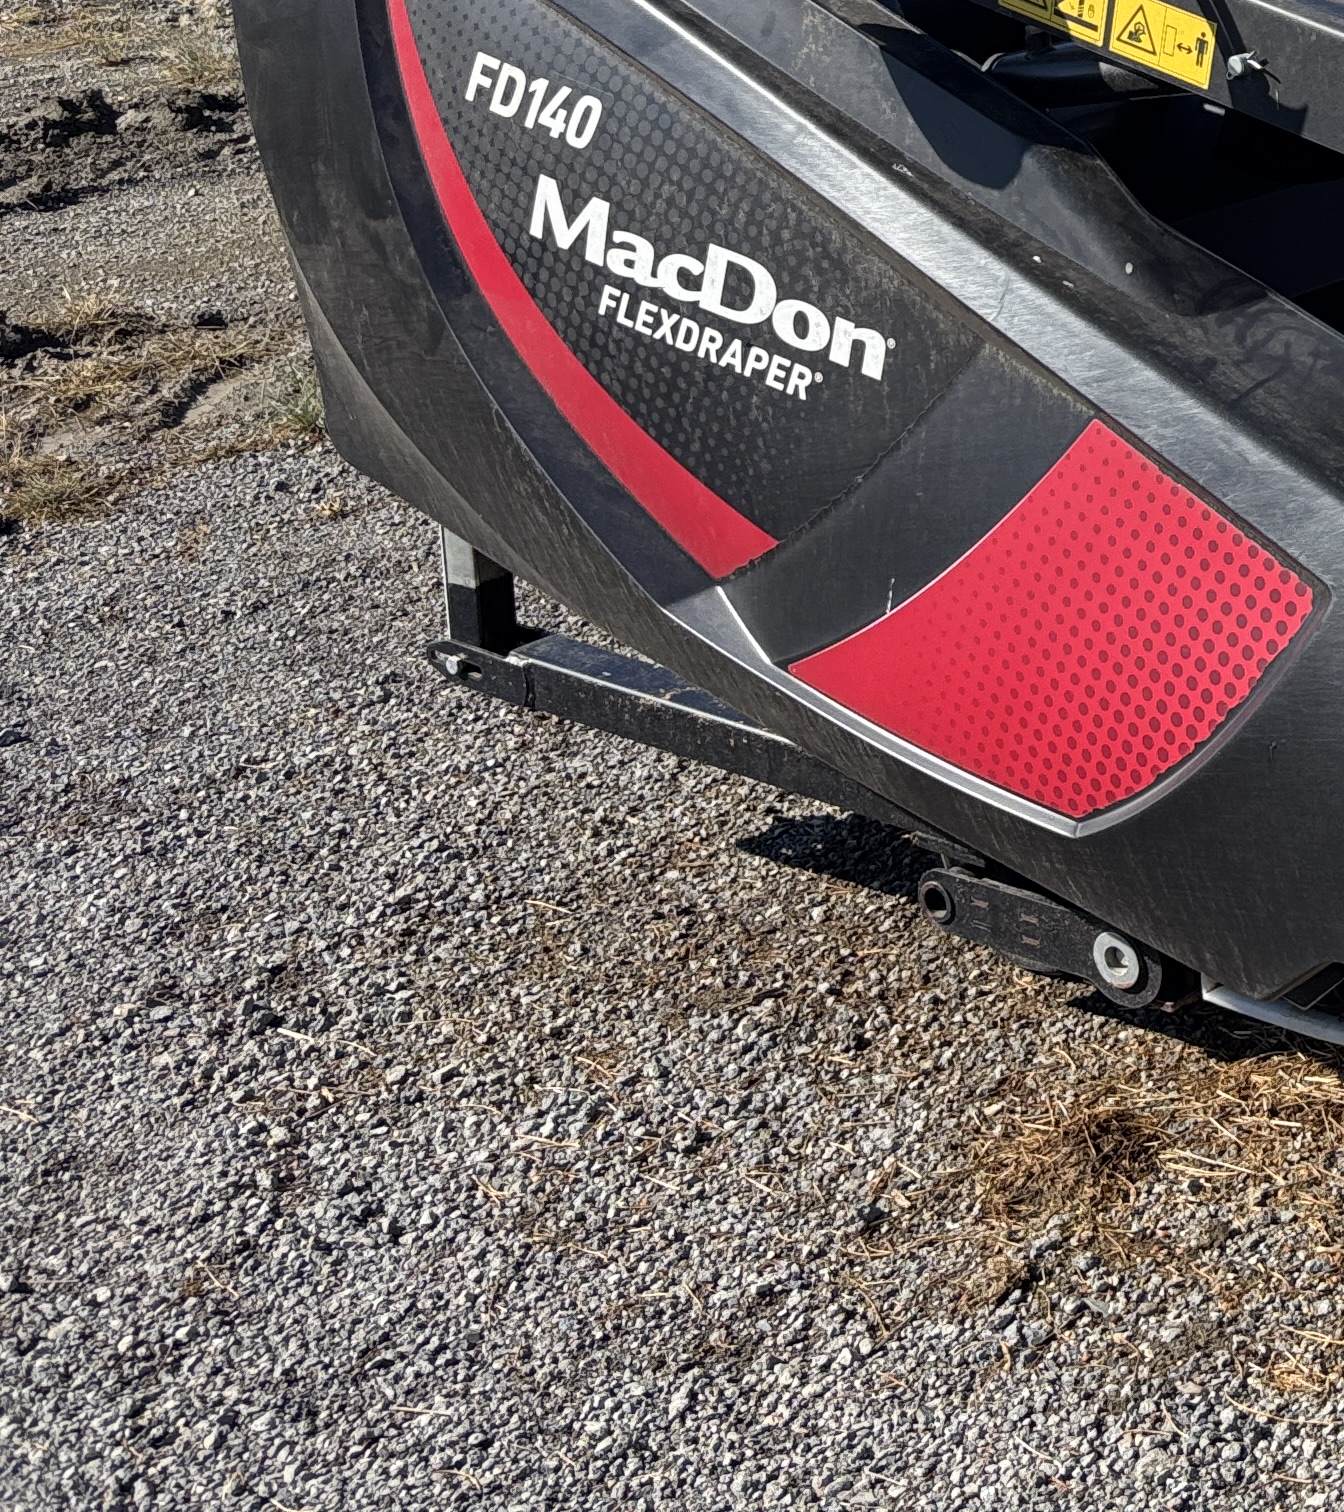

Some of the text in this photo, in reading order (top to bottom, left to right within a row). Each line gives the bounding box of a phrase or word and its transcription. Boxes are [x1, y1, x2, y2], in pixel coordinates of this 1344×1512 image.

[464, 51, 603, 149] FD140
[529, 173, 887, 381] MacDon
[598, 284, 813, 401] FLEXDRAPER
